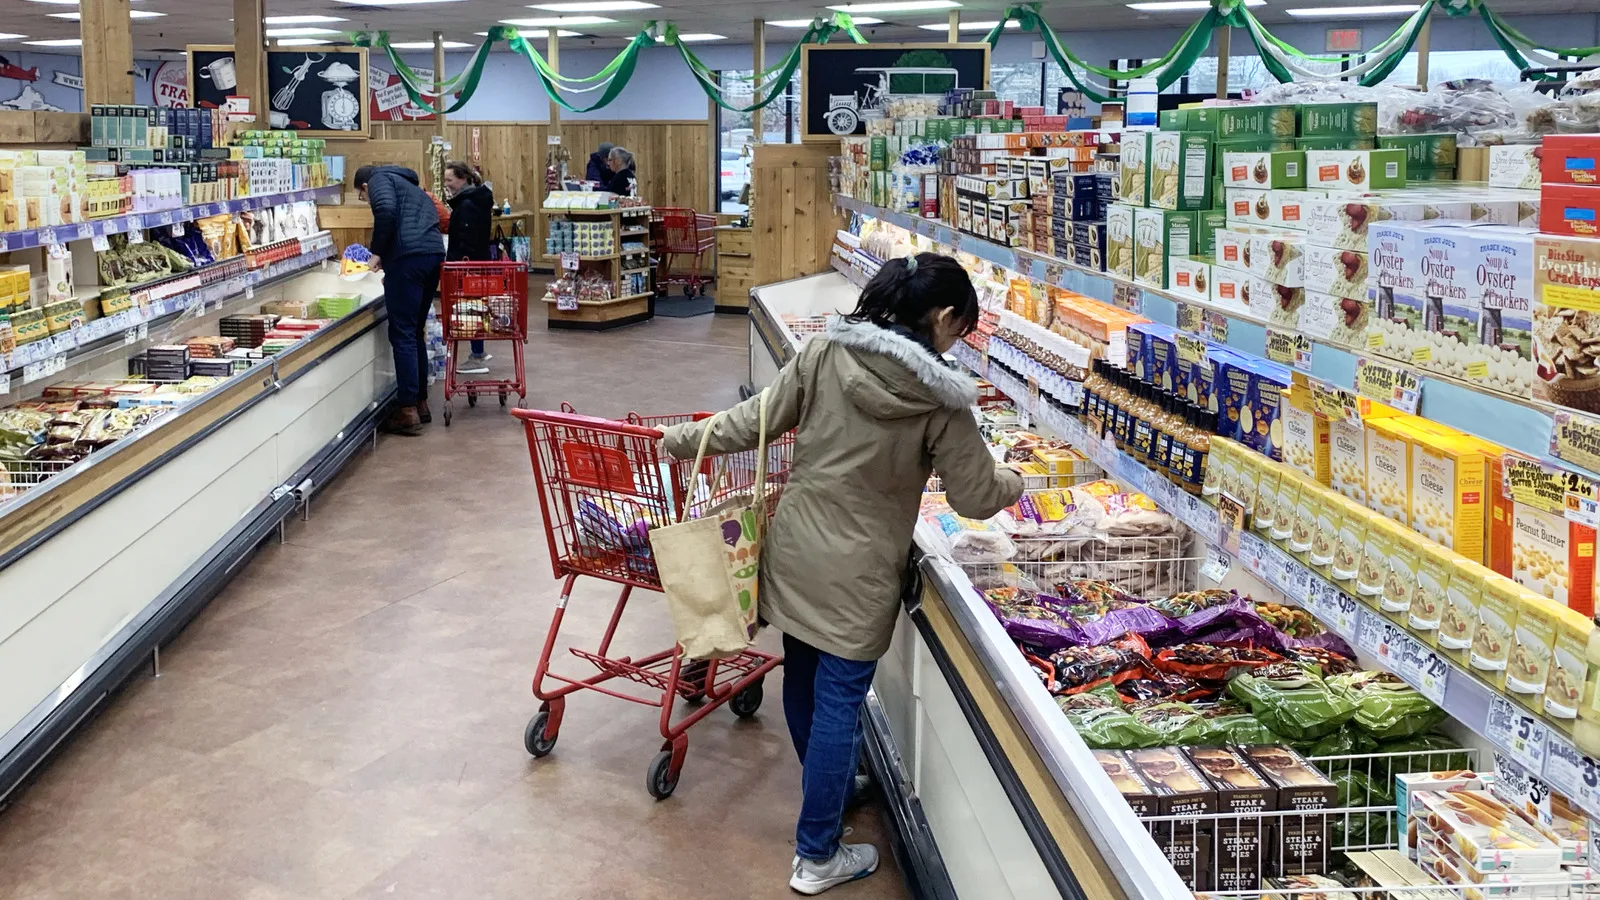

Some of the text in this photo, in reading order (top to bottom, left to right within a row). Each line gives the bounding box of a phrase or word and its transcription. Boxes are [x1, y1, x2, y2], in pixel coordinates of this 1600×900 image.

[160, 83, 187, 100] TRA
[1381, 239, 1393, 254] Soup
[1429, 246, 1443, 262] Soup
[1480, 244, 1517, 256] TRADER JOE'S
[1548, 248, 1584, 262] Bite Size
[1374, 248, 1404, 271] Oyster
[1421, 256, 1455, 280] Oyster
[1486, 253, 1509, 271] Soup &
[1539, 255, 1600, 277] Everythi
[1383, 271, 1414, 289] Crackers
[1477, 264, 1516, 290] Oyster
[1431, 280, 1467, 300] Crackers
[1489, 289, 1529, 311] Crackers
[1363, 365, 1393, 381] OYSTER
[1289, 420, 1306, 437] Cheese
[1337, 436, 1356, 454] Cheese
[1375, 455, 1397, 474] Cheese
[1518, 461, 1541, 472] ORGANI
[1420, 473, 1443, 494] Cheese
[1562, 472, 1592, 496] $2.69
[1516, 517, 1566, 548] Peanut Butter
[1171, 804, 1199, 812] STEAK
[1230, 799, 1257, 807] STEAK
